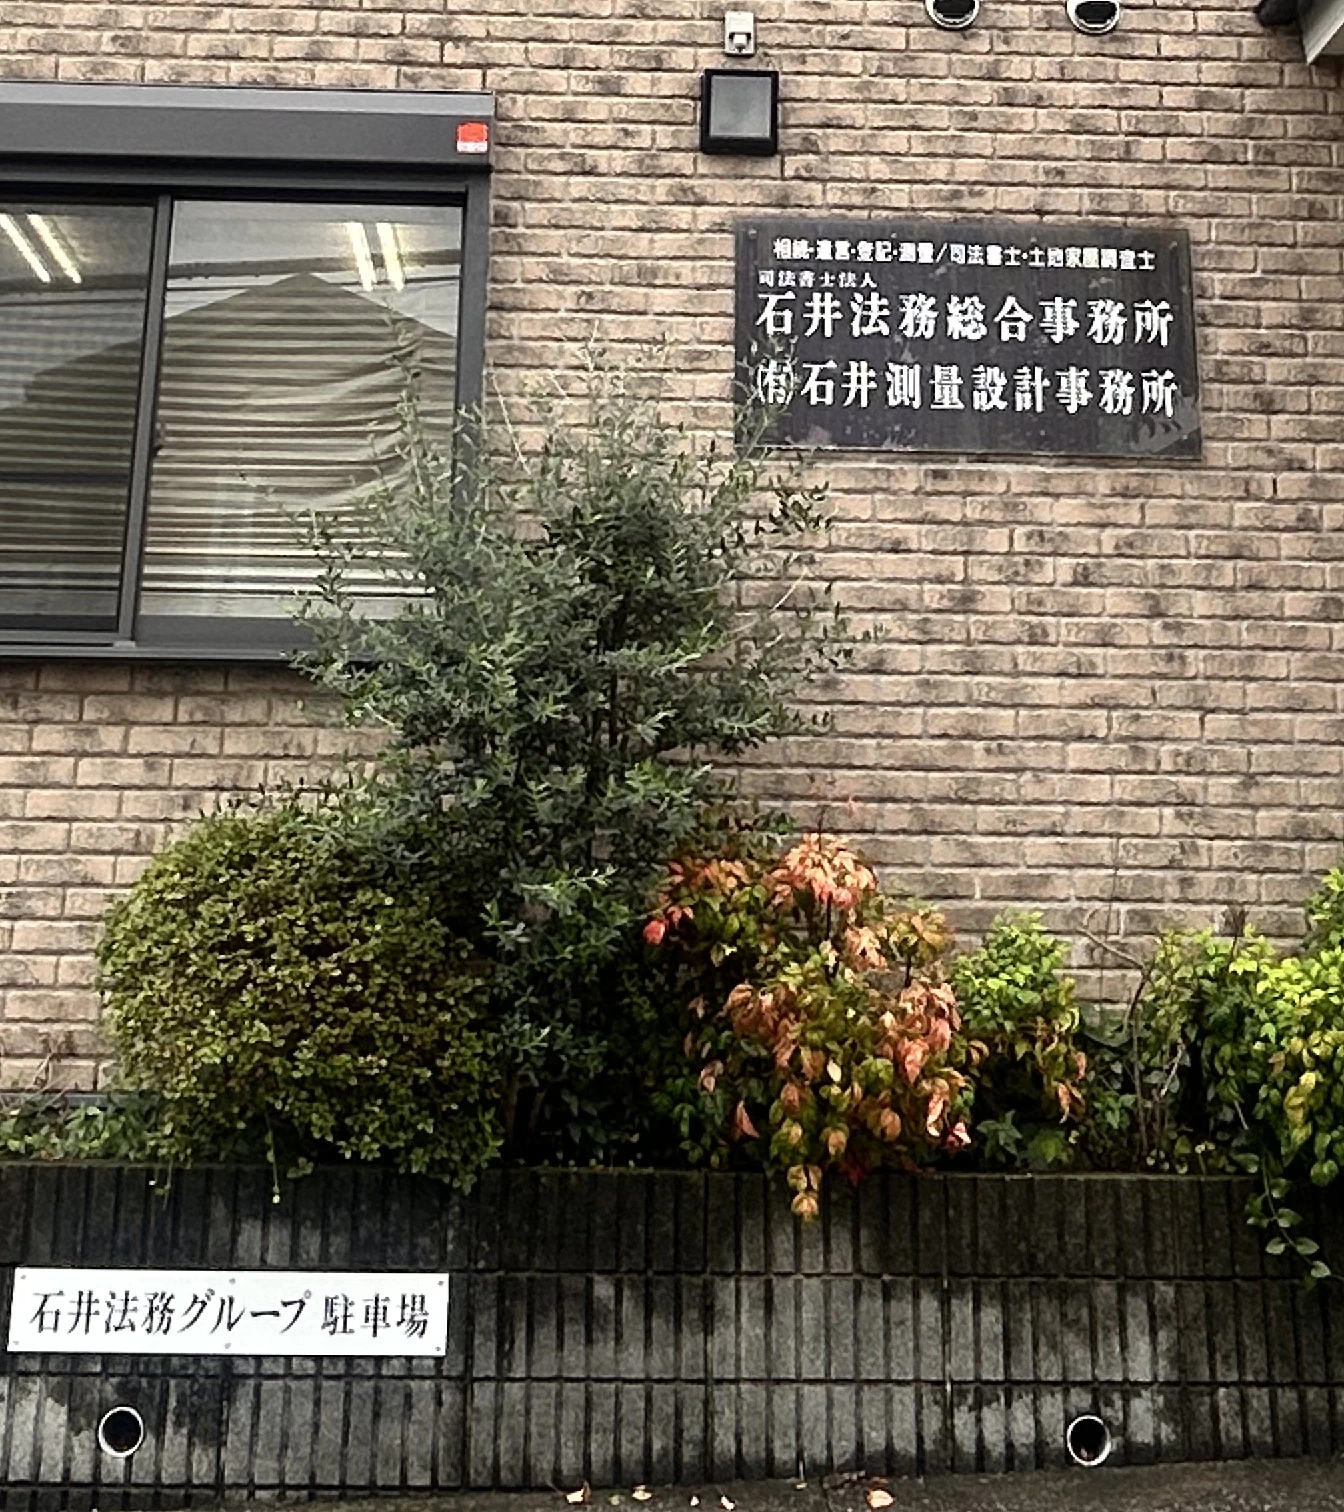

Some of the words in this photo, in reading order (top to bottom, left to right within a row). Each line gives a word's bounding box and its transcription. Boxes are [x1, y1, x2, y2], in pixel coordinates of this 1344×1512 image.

[758, 271, 878, 288] 司法書士法人
[755, 291, 1175, 346] 石井法務総合事務所
